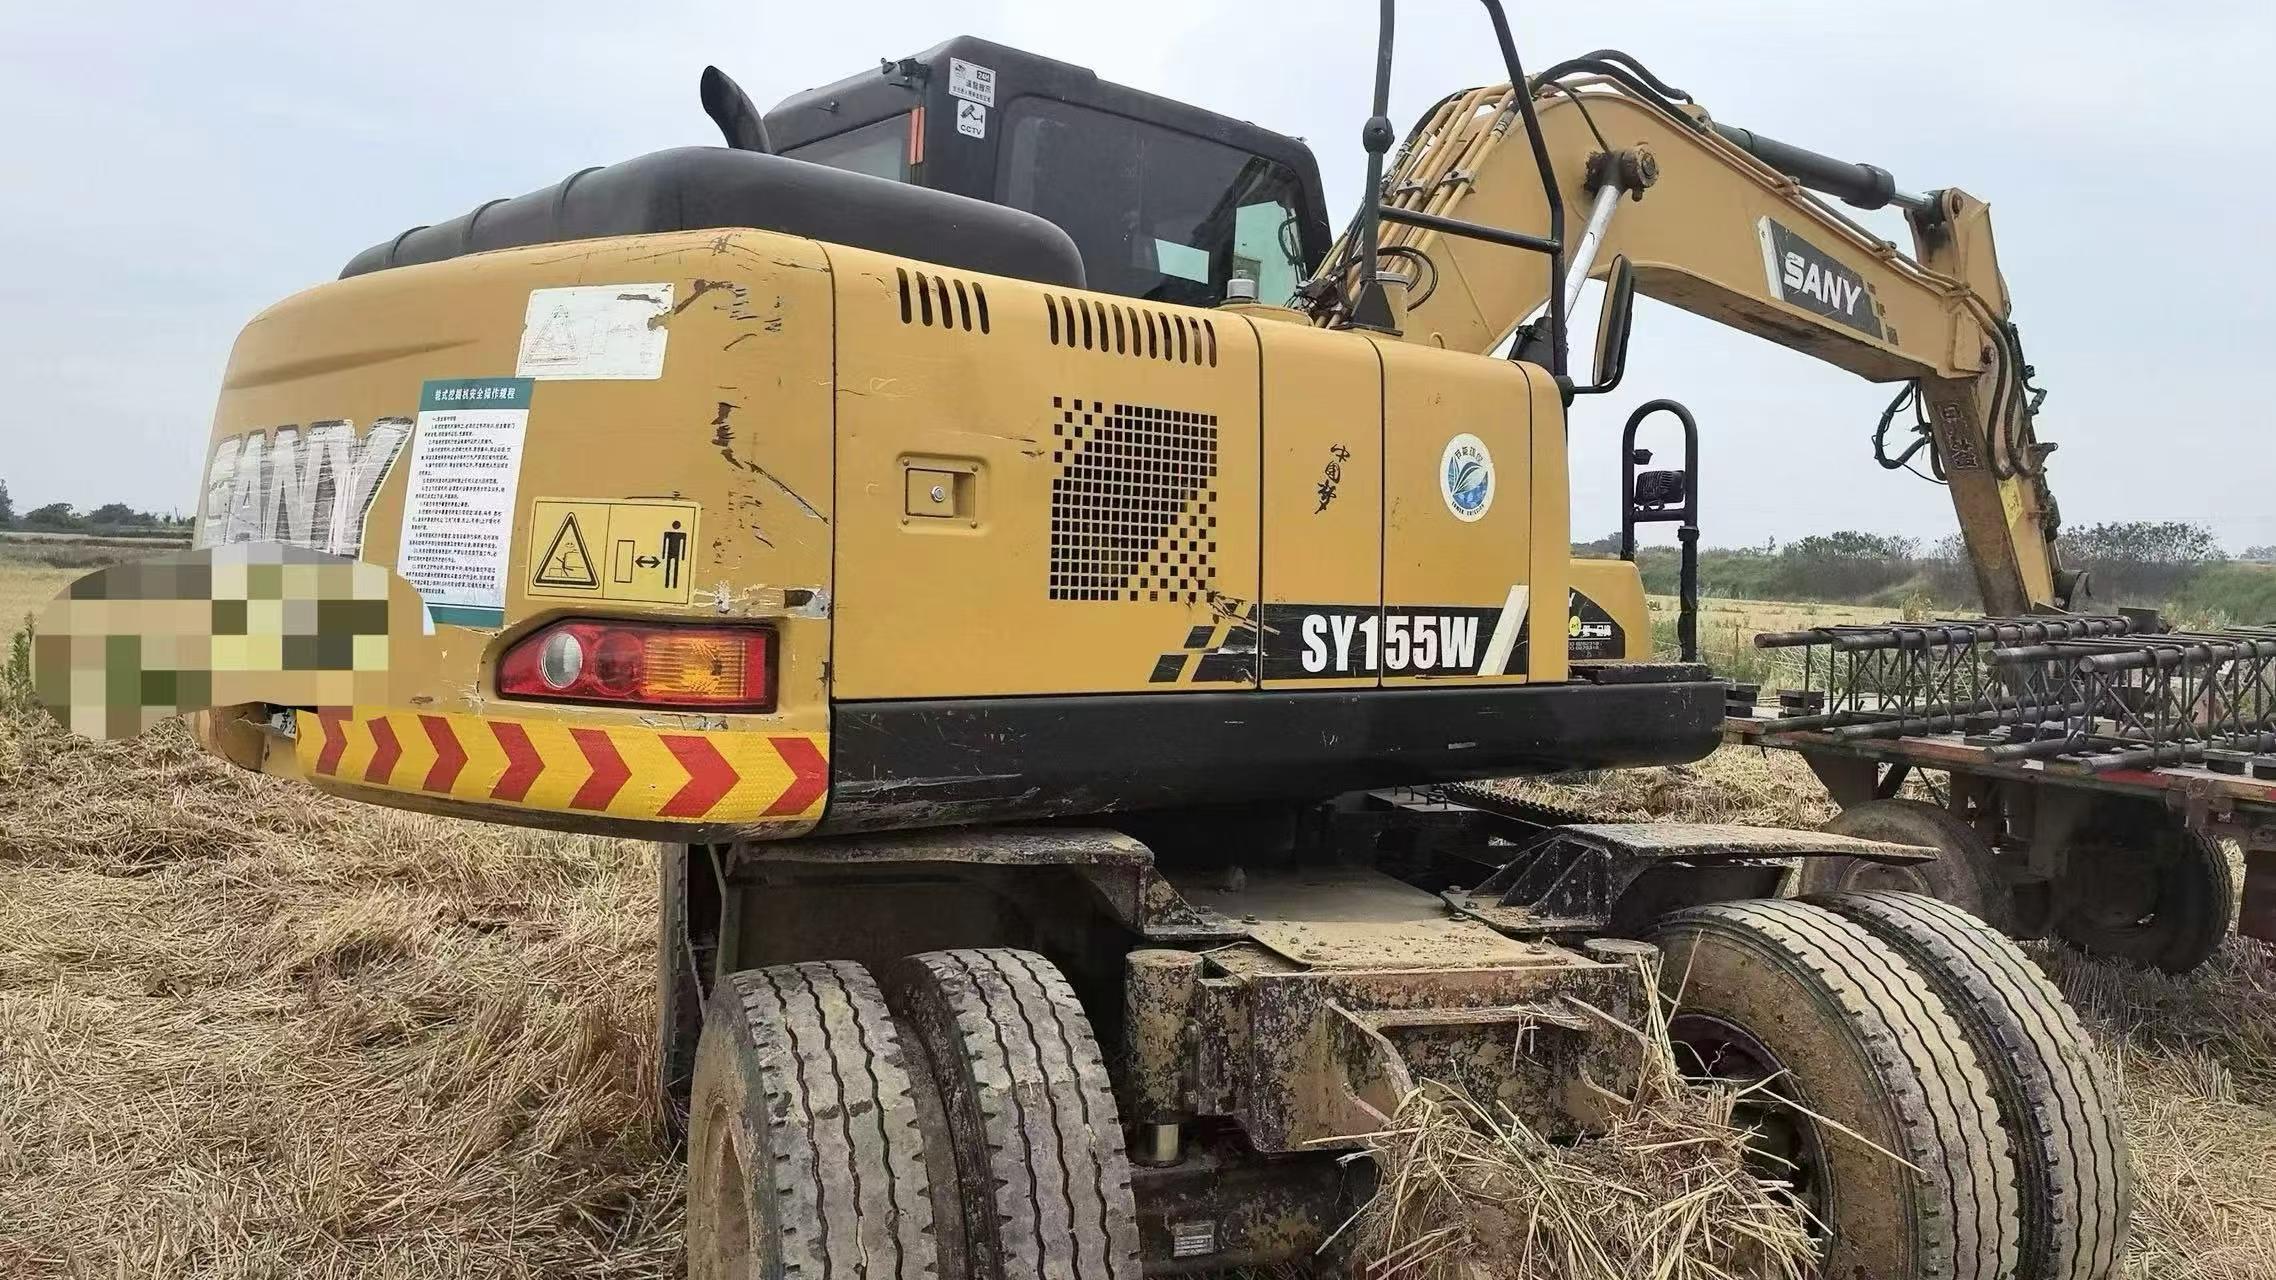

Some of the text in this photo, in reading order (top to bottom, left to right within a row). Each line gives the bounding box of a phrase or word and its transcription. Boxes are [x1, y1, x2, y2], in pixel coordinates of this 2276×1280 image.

[961, 124, 982, 135] CCTV
[1783, 251, 1862, 316] SANY
[202, 416, 414, 560] SANY
[1301, 613, 1479, 673] SY155W
